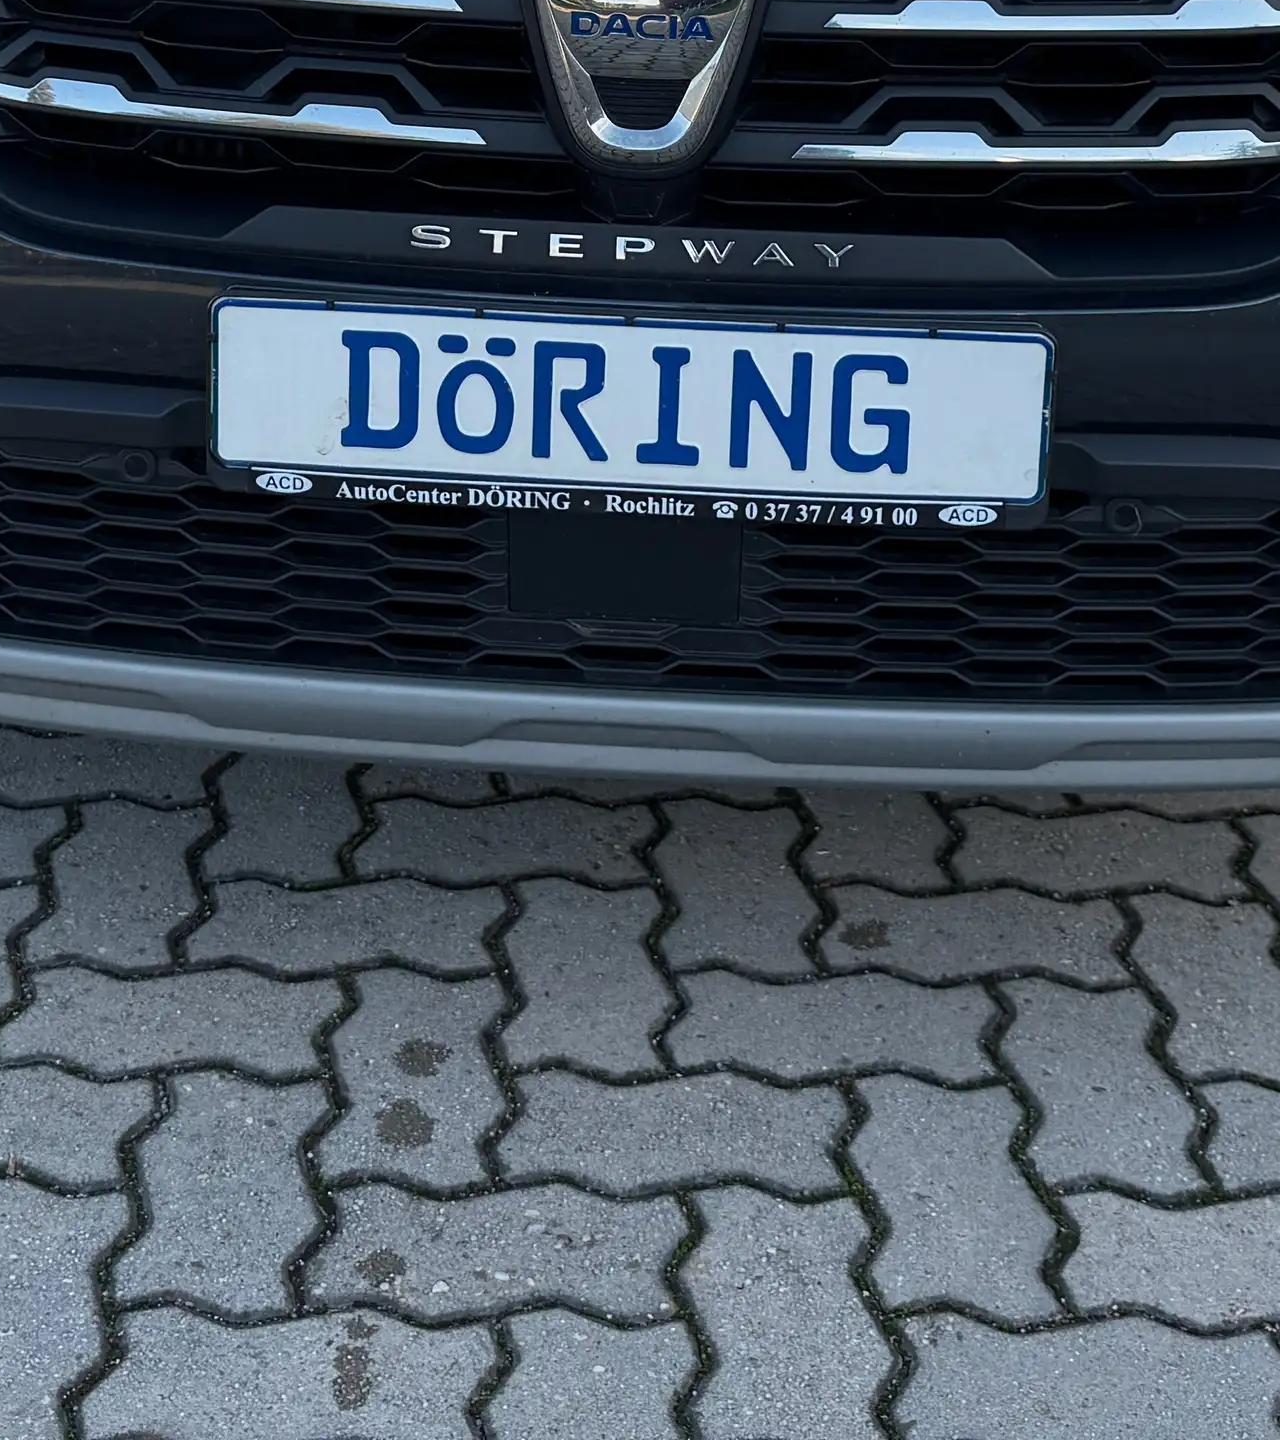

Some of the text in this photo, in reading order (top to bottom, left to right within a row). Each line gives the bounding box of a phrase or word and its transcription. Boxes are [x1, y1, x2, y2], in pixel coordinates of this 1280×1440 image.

[570, 11, 713, 42] DACIA
[410, 224, 854, 268] STEPWAY
[341, 329, 910, 474] DÖRING
[265, 476, 305, 492] ACD
[335, 481, 462, 506] AutoCenter
[467, 485, 571, 510] DÖRING
[605, 495, 695, 517] Rochlitz
[745, 503, 758, 520] 0
[764, 504, 789, 522] 37
[795, 505, 822, 523] 37
[841, 506, 854, 523] 4
[860, 507, 884, 524] 91
[892, 508, 918, 526] 00
[947, 507, 989, 523] ACD
